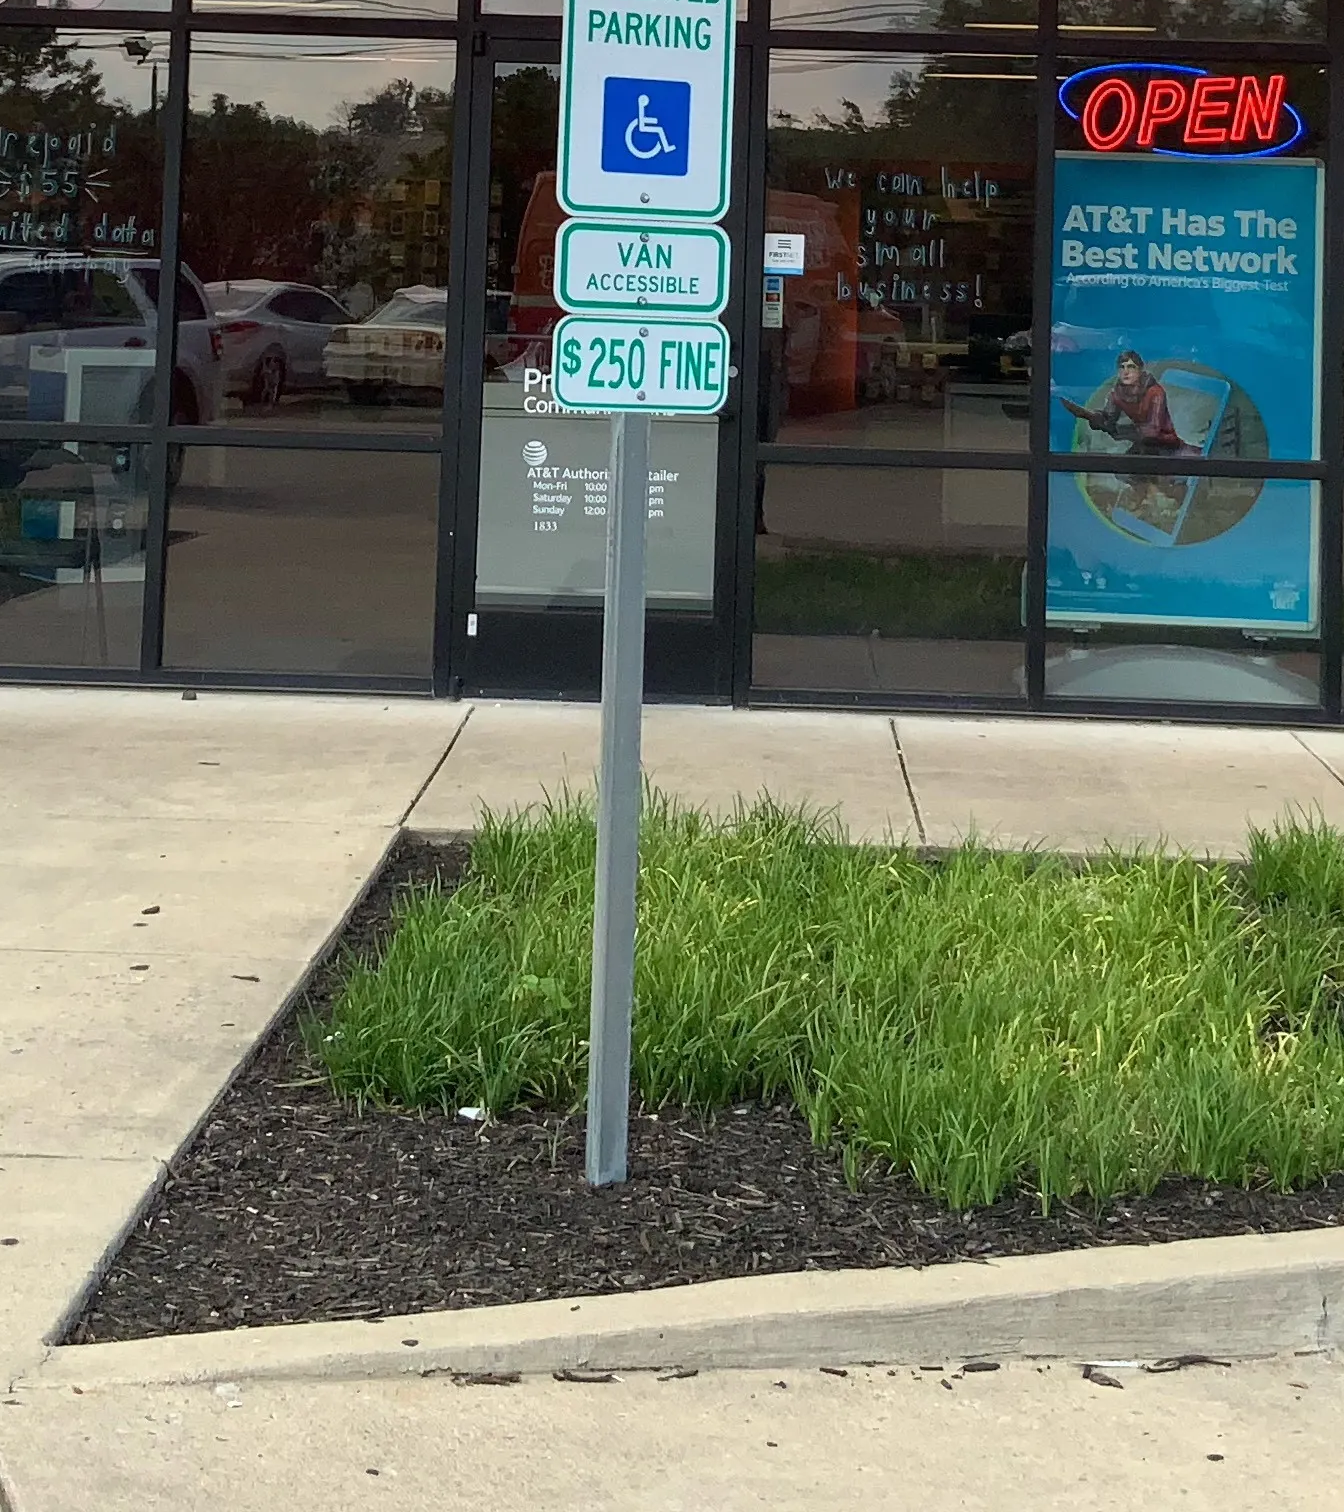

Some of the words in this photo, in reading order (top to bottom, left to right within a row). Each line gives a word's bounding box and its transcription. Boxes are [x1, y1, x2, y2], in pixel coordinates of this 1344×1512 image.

[587, 10, 712, 51] PARKING
[1083, 75, 1286, 150] OPEN
[16, 164, 79, 202] $55
[824, 167, 856, 189] We
[878, 172, 922, 196] can
[941, 166, 1000, 208] help
[94, 213, 154, 247] data
[866, 208, 937, 235] your
[1062, 205, 1153, 234] AT&T
[1162, 208, 1226, 237] Has
[1233, 209, 1298, 240] The
[617, 242, 673, 269] VAN
[856, 239, 944, 268] small
[1061, 240, 1139, 270] Best
[1147, 243, 1298, 275] Network
[586, 273, 700, 295] ACCESSIBLE
[837, 272, 983, 308] business!
[1066, 272, 1129, 288] According
[1131, 274, 1146, 286] to
[1212, 277, 1261, 293] Biggest
[659, 340, 721, 392] FINE
[527, 467, 560, 479] AT&T
[562, 467, 609, 480] Authori
[649, 470, 680, 482] tailer
[533, 481, 568, 492] Mon-Fri
[532, 505, 565, 517] Sunday
[533, 493, 573, 505] Saturday
[533, 521, 559, 532] 1833
